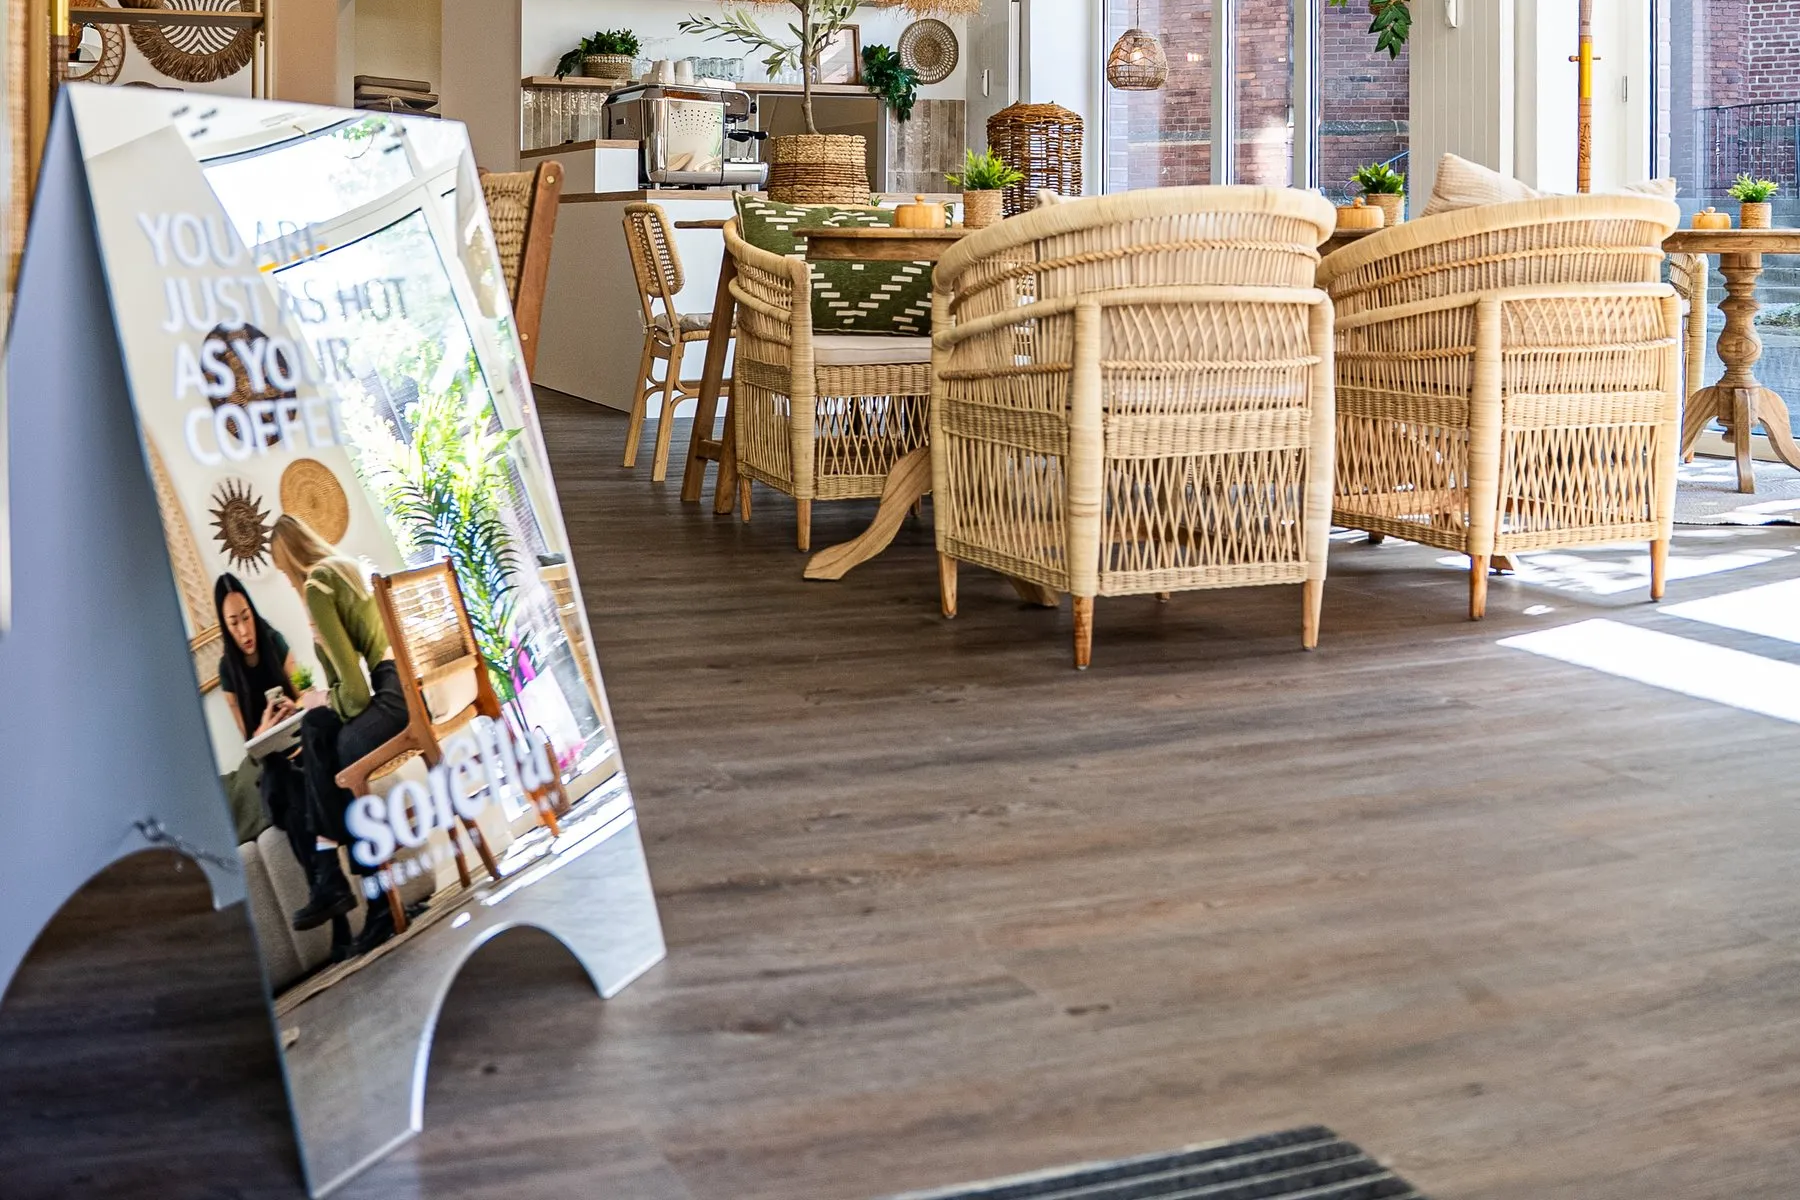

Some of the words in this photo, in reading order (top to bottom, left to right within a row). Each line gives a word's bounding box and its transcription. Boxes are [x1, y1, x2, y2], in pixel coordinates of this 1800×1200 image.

[136, 211, 243, 268] YOU
[252, 219, 327, 265] ARE
[161, 276, 267, 333] JUST
[277, 278, 327, 326] AS
[336, 276, 407, 322] HOT
[173, 337, 236, 401] AS
[231, 335, 356, 392] YOUR
